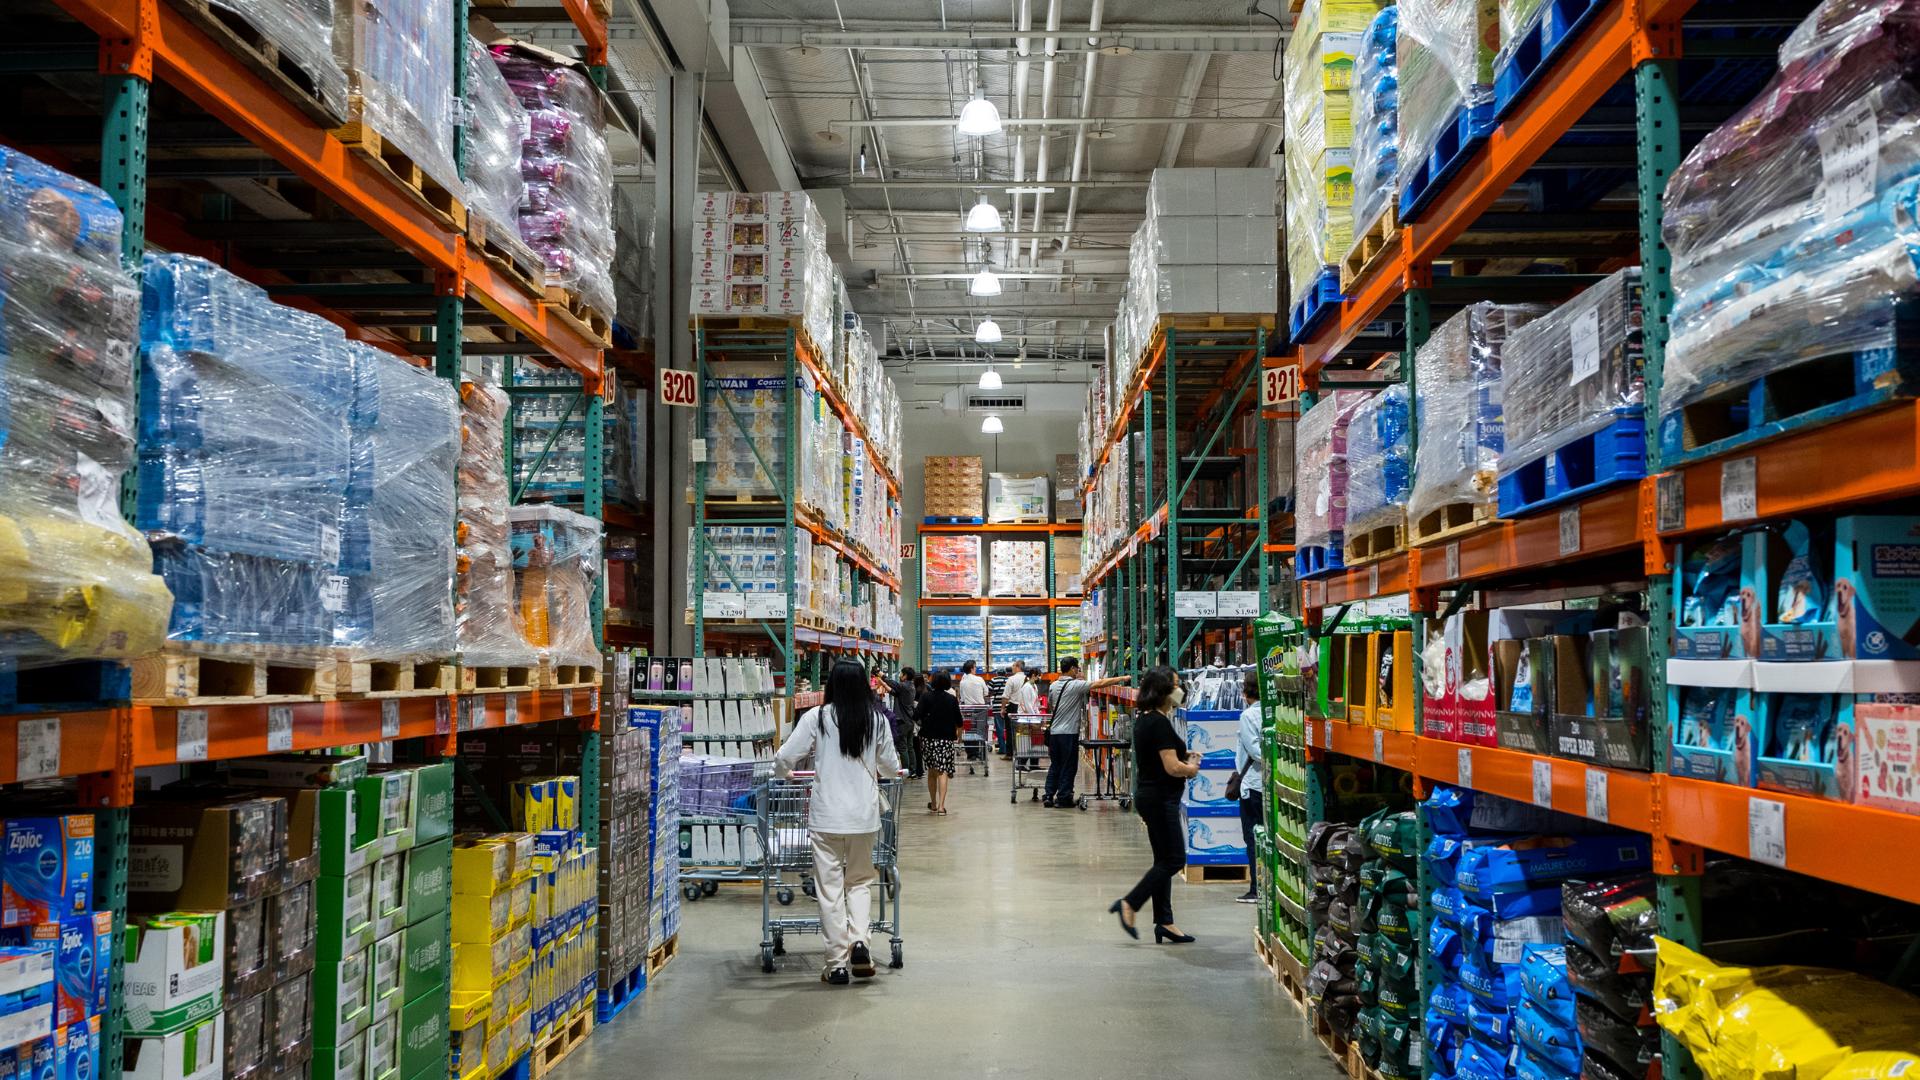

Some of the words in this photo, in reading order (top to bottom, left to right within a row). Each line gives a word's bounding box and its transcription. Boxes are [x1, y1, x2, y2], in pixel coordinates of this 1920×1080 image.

[1330, 68, 1348, 77] 金萱
[1330, 78, 1348, 87] 烏龍
[1332, 182, 1350, 191] 金萱
[1332, 192, 1350, 201] 烏龍
[663, 372, 695, 404] 320
[1267, 368, 1294, 402] 321
[1481, 425, 1503, 433] 3000
[1503, 732, 1519, 747] SUPER
[1519, 734, 1535, 749] BARS
[1559, 736, 1578, 754] SUPER
[1578, 738, 1595, 757] BARS
[1609, 744, 1630, 762] BARS
[70, 818, 92, 828] QUART
[10, 832, 42, 853] Ziploc
[74, 840, 91, 856] 216
[1383, 836, 1392, 847] DOG
[129, 854, 170, 873] 鎖鮮袋
[1530, 861, 1564, 872] MATURE
[1566, 859, 1587, 868] DOG
[1388, 916, 1398, 926] DOG
[62, 931, 82, 954] Ziploc
[100, 936, 110, 951] 216
[134, 983, 157, 996] BAG
[1475, 976, 1491, 991] DOG
[1387, 992, 1398, 1003] DOG
[1442, 997, 1455, 1011] DOG
[69, 1035, 88, 1052] Ziploc
[34, 1048, 53, 1066] Ziploc
[1388, 1063, 1399, 1076] DOG
